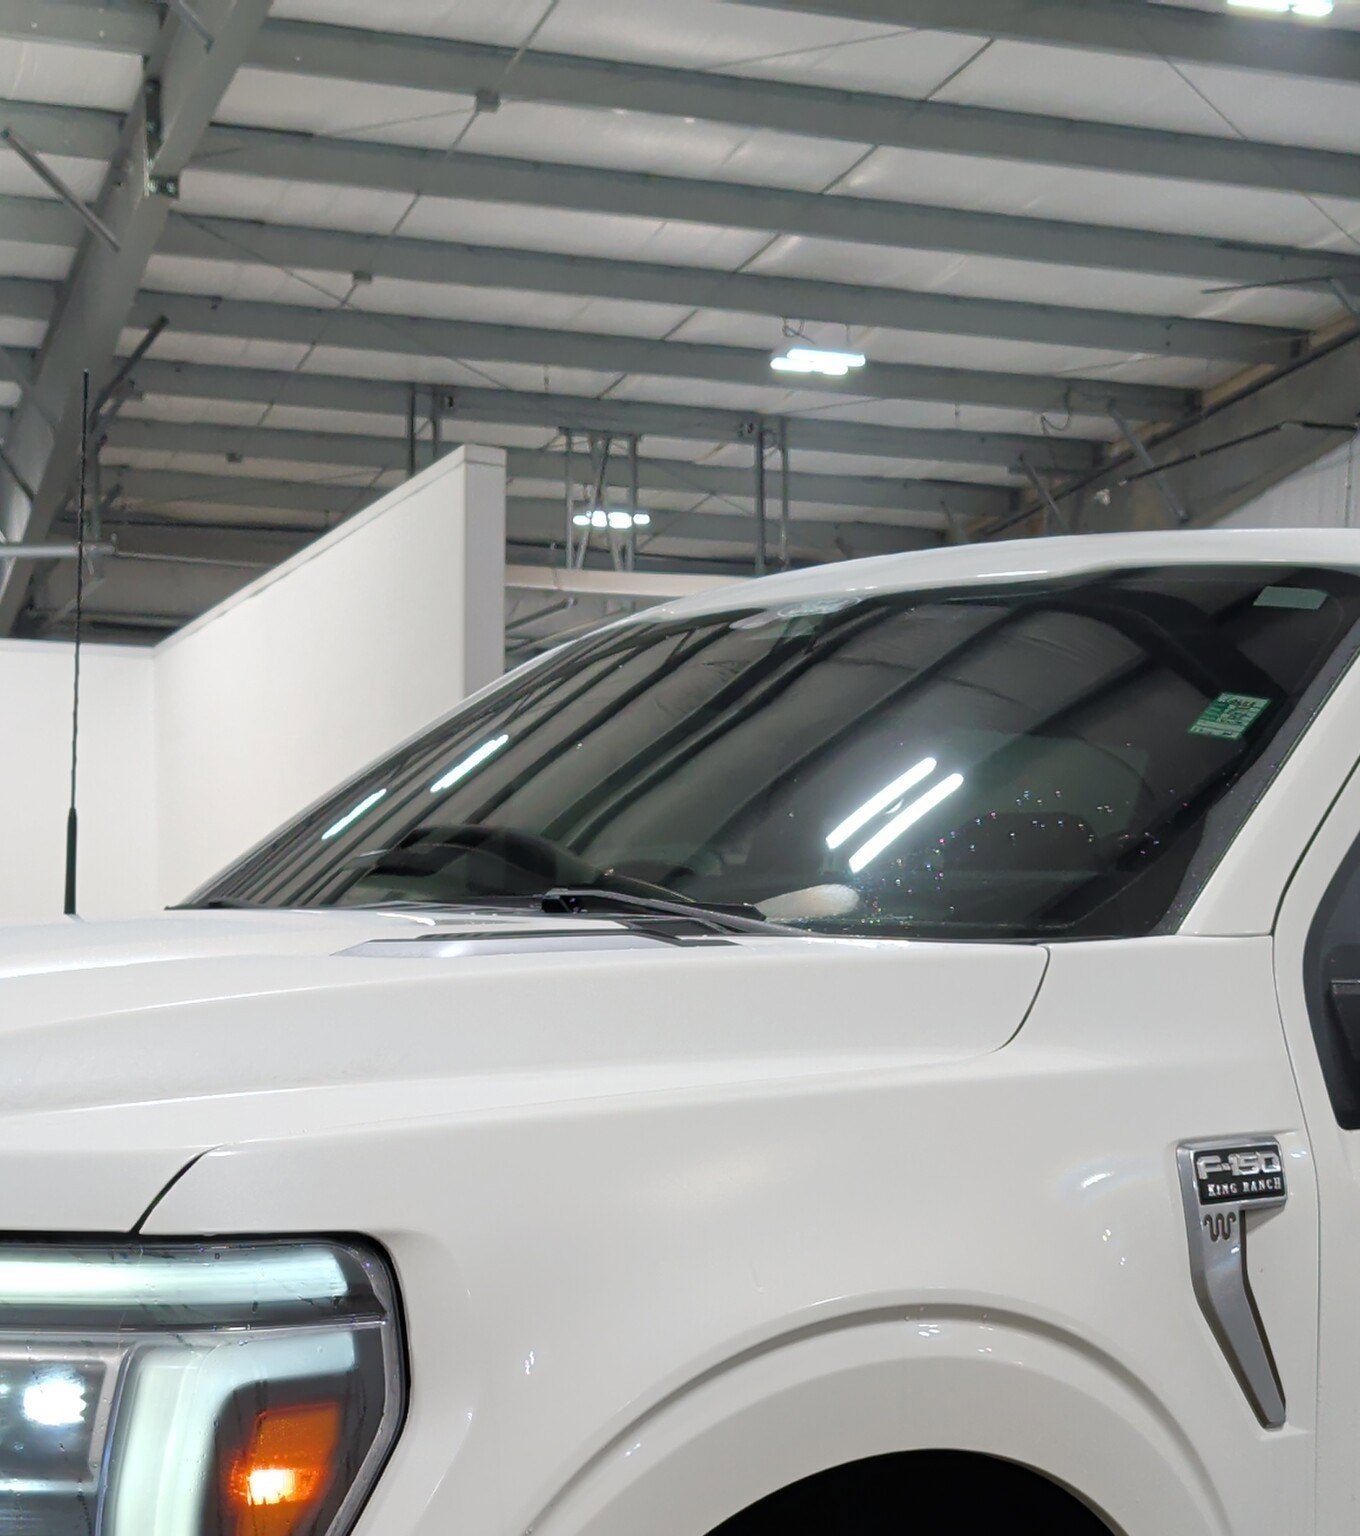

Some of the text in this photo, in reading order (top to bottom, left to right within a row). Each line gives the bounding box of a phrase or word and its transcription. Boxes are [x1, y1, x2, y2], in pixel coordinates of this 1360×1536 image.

[1196, 1150, 1282, 1180] F-150
[1207, 1176, 1282, 1197] KING RANCH
